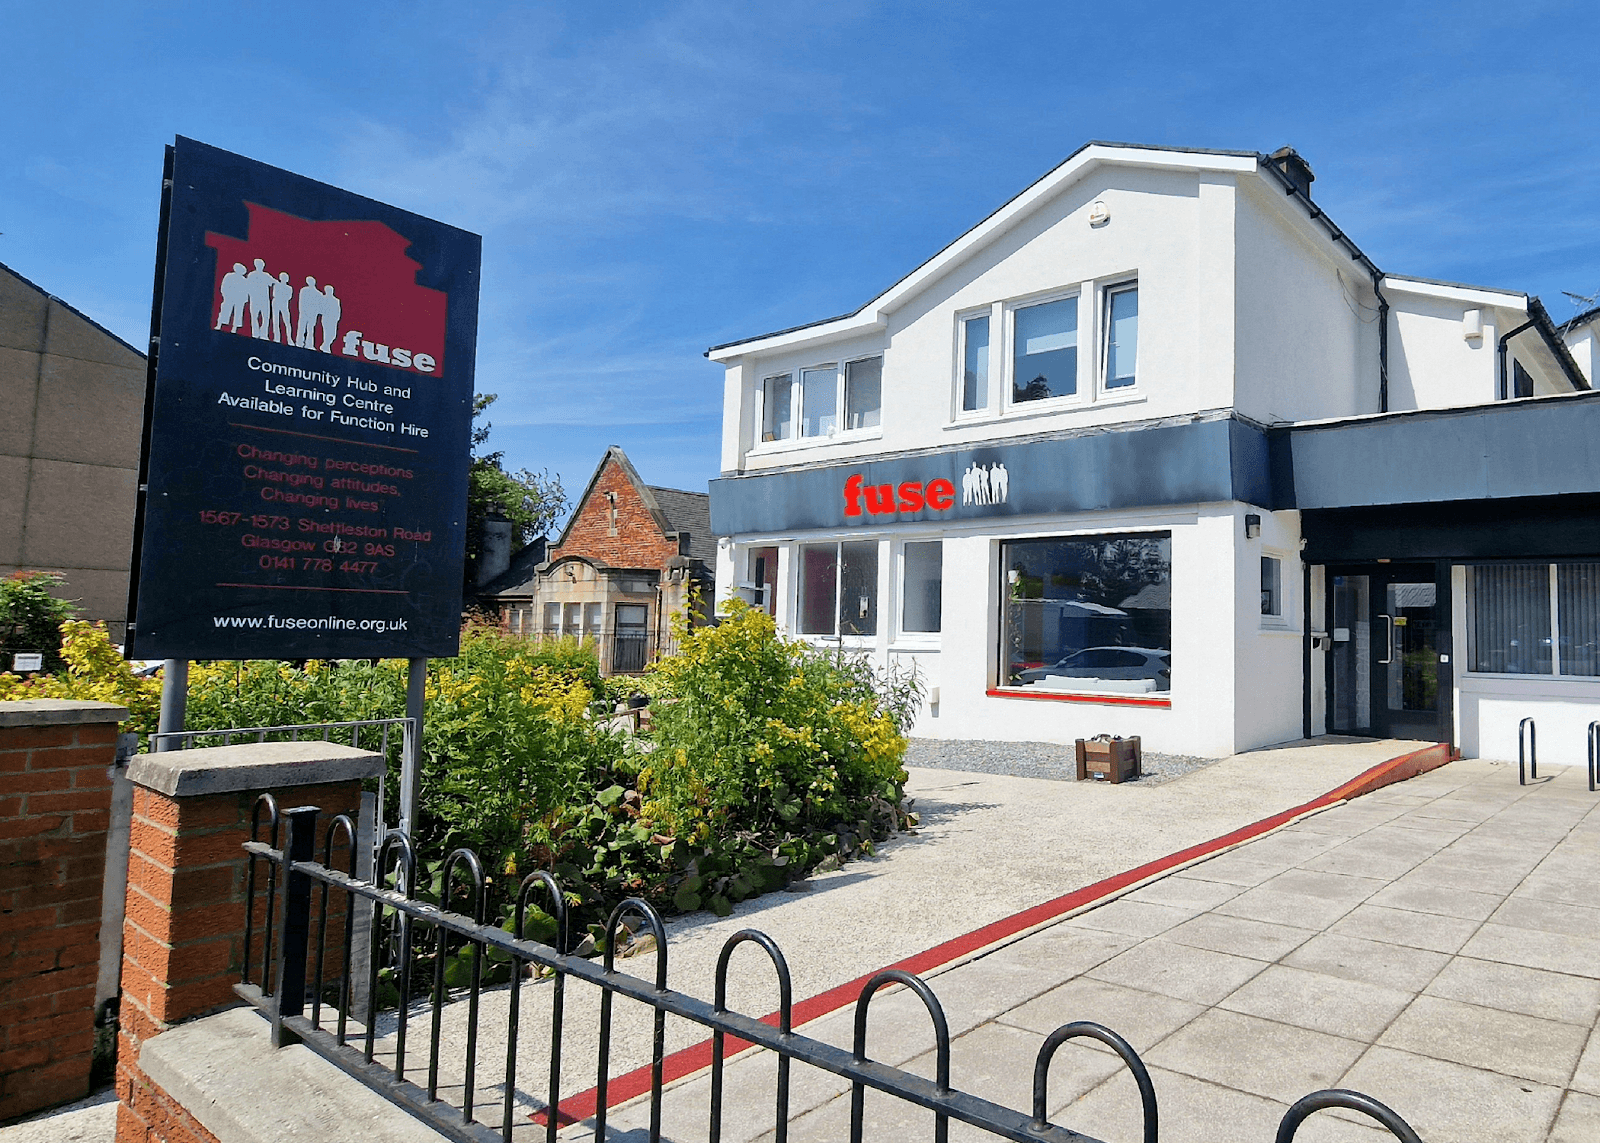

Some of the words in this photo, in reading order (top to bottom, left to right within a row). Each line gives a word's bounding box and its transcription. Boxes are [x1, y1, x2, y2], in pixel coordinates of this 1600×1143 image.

[342, 330, 436, 372] fuse
[247, 356, 341, 388] Community
[347, 376, 378, 393] Hub
[383, 384, 411, 399] and
[265, 380, 336, 407] Learning
[343, 393, 394, 414] Centre
[218, 391, 294, 416] Available
[301, 405, 324, 421] for
[330, 410, 395, 433] Function
[401, 423, 429, 438] Hire
[237, 443, 318, 469] Changing
[325, 458, 414, 480] perceptions
[243, 465, 324, 489] Changing
[330, 476, 401, 497] attitudes,
[843, 473, 956, 517] fuse
[260, 487, 340, 509] Changing
[198, 510, 290, 530] 1567-1573
[298, 518, 387, 538] Shettleston
[393, 527, 432, 542] Road
[241, 533, 316, 552] Glasgow
[364, 542, 396, 556] 9AS
[258, 554, 296, 570] 0141
[302, 557, 333, 572] 778
[339, 560, 379, 574] 4477
[213, 614, 409, 634] www.fuseonline.org.uk
